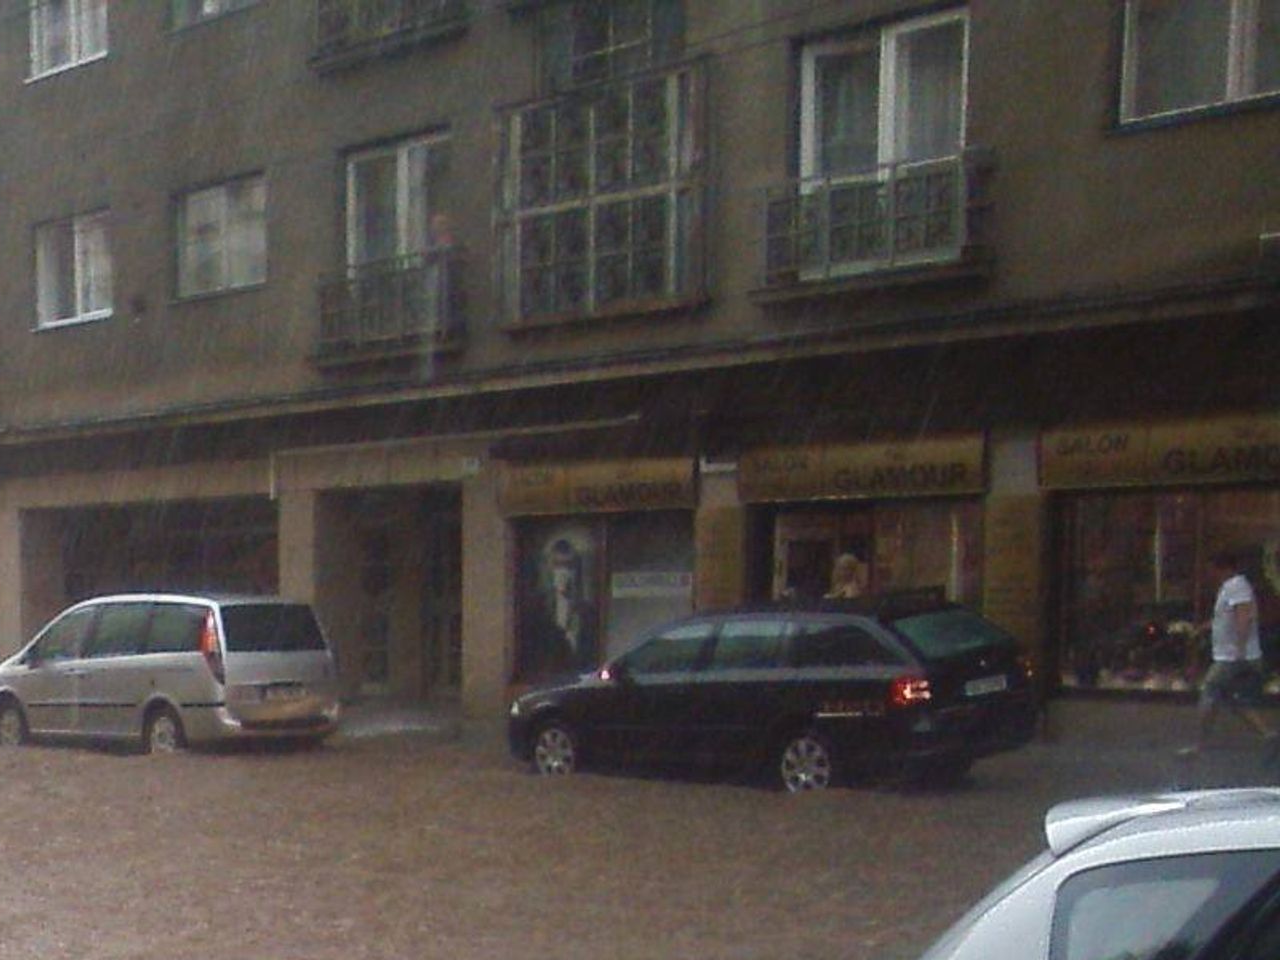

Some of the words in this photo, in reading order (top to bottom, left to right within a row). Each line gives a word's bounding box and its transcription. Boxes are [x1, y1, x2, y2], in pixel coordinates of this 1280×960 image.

[1056, 433, 1130, 456] SALON
[833, 462, 968, 492] GLAMOUR
[575, 481, 683, 508] GLAMOUR
